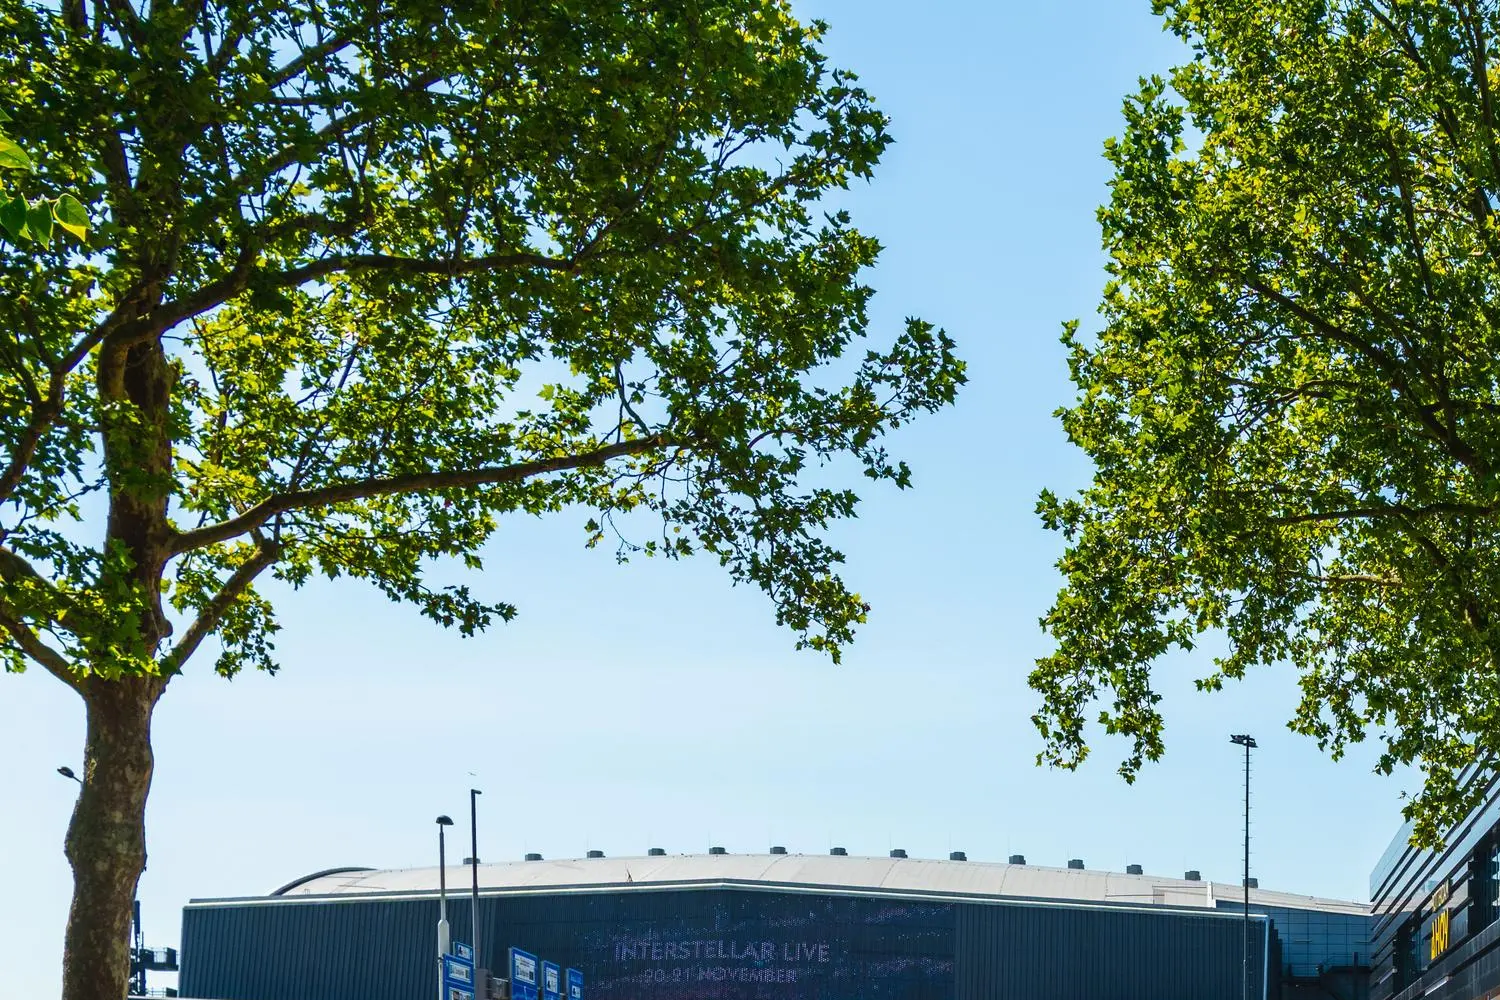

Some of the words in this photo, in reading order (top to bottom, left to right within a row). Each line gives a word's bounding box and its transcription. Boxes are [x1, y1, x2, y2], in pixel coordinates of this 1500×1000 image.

[1431, 907, 1449, 961] AHOY
[615, 940, 776, 961] INTERSTELLAR
[784, 942, 831, 962] LIVE
[698, 966, 798, 983] NOVEMBER
